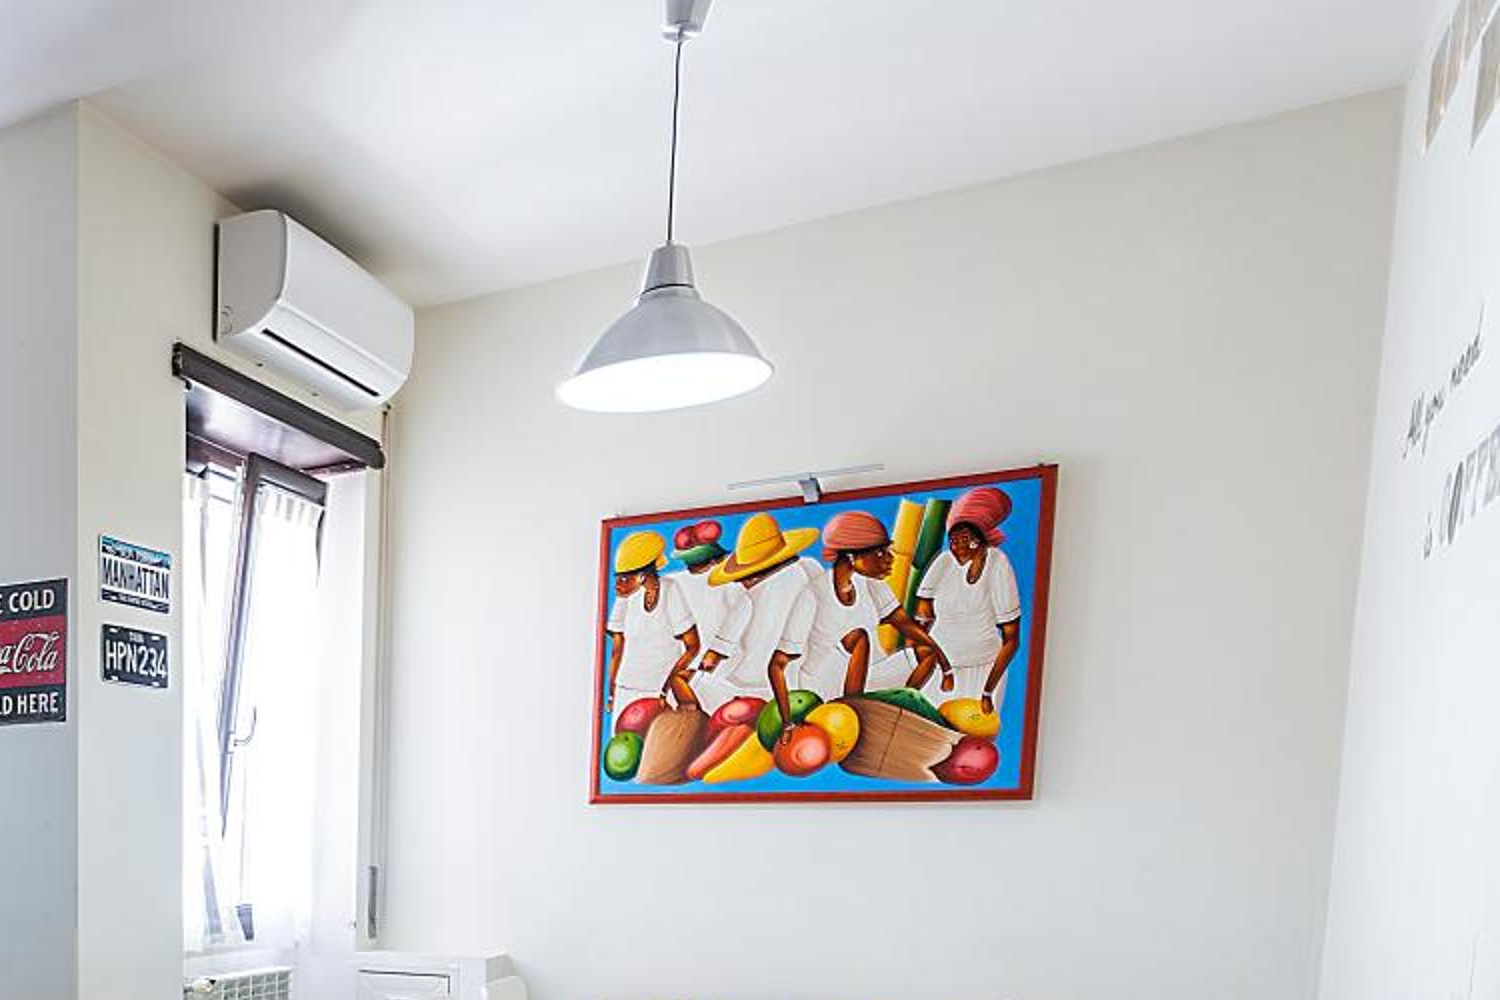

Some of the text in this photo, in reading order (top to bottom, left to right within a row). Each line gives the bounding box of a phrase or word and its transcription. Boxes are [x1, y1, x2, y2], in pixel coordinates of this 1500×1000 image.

[102, 557, 169, 600] MANHATTAN
[9, 589, 55, 613] COLD
[106, 640, 166, 679] HPN234
[17, 692, 59, 714] HERE
